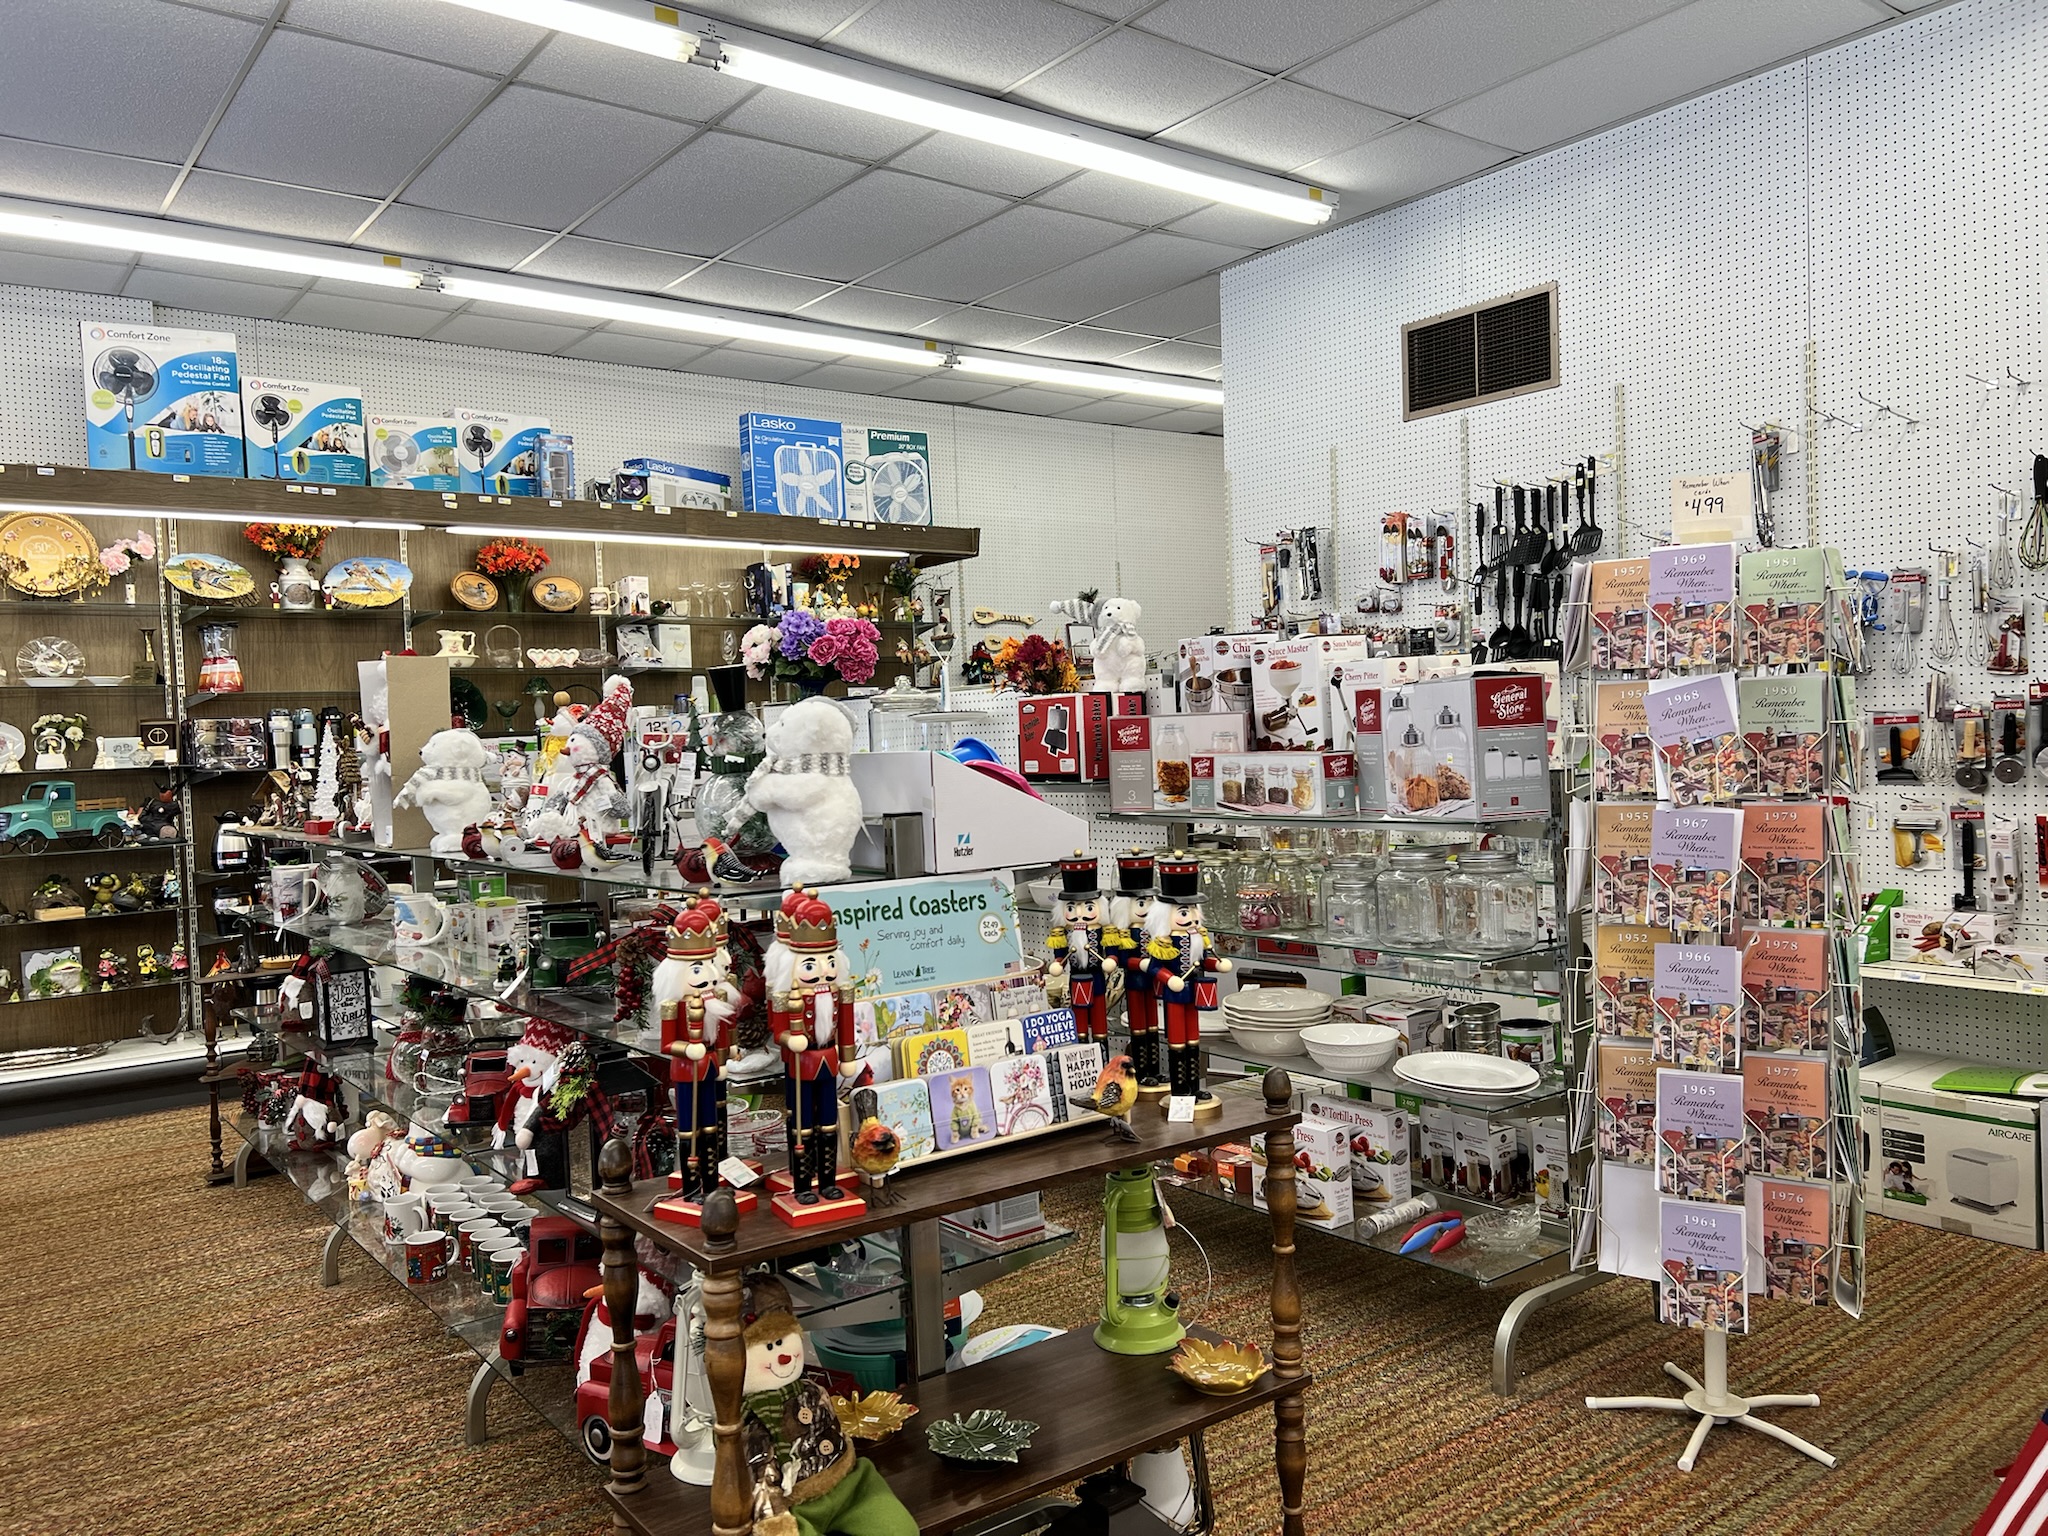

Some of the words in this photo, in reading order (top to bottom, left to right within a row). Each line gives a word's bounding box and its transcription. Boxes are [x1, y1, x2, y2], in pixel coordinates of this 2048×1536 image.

[106, 329, 145, 340] Comfort
[147, 332, 171, 342] Zone
[181, 362, 229, 374] Oscillating
[171, 370, 211, 380] Pedestal
[213, 373, 230, 381] Fan
[262, 382, 291, 391] Comfort
[292, 384, 309, 393] Zone
[321, 412, 344, 420] Pedestal
[326, 407, 356, 415] Oscillating
[471, 413, 493, 422] Comfort
[752, 416, 796, 431] Lasko
[842, 427, 864, 435] Lasko
[871, 431, 910, 442] Premium
[762, 436, 785, 444] Circulating
[647, 461, 674, 474] Lasko
[1673, 554, 1707, 565] 1969
[1766, 556, 1798, 568] 1981
[1613, 565, 1643, 576] 1957
[1661, 568, 1715, 579] Remember
[1753, 569, 1808, 581] Remember
[1268, 648, 1285, 657] Sauce
[1287, 645, 1309, 653] Master
[1344, 673, 1362, 682] Cherry
[1363, 672, 1379, 680] Pitter
[1491, 687, 1528, 704] General
[1620, 689, 1648, 699] 1956
[1763, 685, 1797, 696] 1980
[1666, 689, 1701, 706] 1968
[1752, 698, 1806, 709] Remember
[1092, 698, 1101, 721] Baker
[1497, 702, 1525, 720] Store
[1658, 702, 1712, 722] Remember
[1128, 790, 1136, 800] 3
[1369, 786, 1374, 800] 3
[1619, 812, 1649, 821] 1955
[1764, 812, 1798, 821] 1979
[1674, 818, 1709, 829] 1967
[1752, 823, 1806, 833] Remember
[1662, 829, 1716, 841] Remember
[953, 845, 974, 857] Hutzler
[831, 897, 903, 930] nspired
[910, 890, 987, 916] Coasters
[1902, 913, 1921, 921] French
[983, 921, 998, 929] $2.49
[877, 929, 910, 941] Serving
[911, 928, 926, 941] joy
[929, 924, 943, 935] and
[1617, 933, 1648, 943] 1952
[910, 938, 943, 950] comfort
[947, 935, 965, 948] daily
[1765, 939, 1798, 951] 1978
[1678, 951, 1711, 962] 1966
[1752, 950, 1806, 963] Remember
[921, 966, 936, 975] TREE
[1665, 962, 1720, 975] Remember
[330, 1008, 366, 1025] WORLD
[1025, 1020, 1029, 1028] I
[1031, 1016, 1044, 1026] DO
[1046, 1011, 1072, 1023] YOGA
[1027, 1028, 1039, 1038] TO
[1040, 1021, 1074, 1035] RELIEVE
[1044, 1031, 1076, 1045] STRESS
[1065, 1052, 1078, 1062] WHY
[1079, 1048, 1095, 1059] LIMIT
[1622, 1056, 1653, 1066] 1953
[1067, 1059, 1096, 1072] HAPPY
[1765, 1066, 1799, 1077] 1977
[1070, 1077, 1097, 1090] HOUR
[1754, 1078, 1808, 1091] Remember
[1682, 1084, 1716, 1096] 1965
[1670, 1096, 1725, 1109] Remember
[1329, 1108, 1353, 1123] Tortilla
[1355, 1114, 1373, 1128] Press
[1296, 1128, 1314, 1143] Press
[1988, 1128, 2032, 1143] AIRCARE
[1771, 1191, 1804, 1203] 1976
[1684, 1215, 1717, 1228] 1964
[1672, 1226, 1726, 1242] Remember
